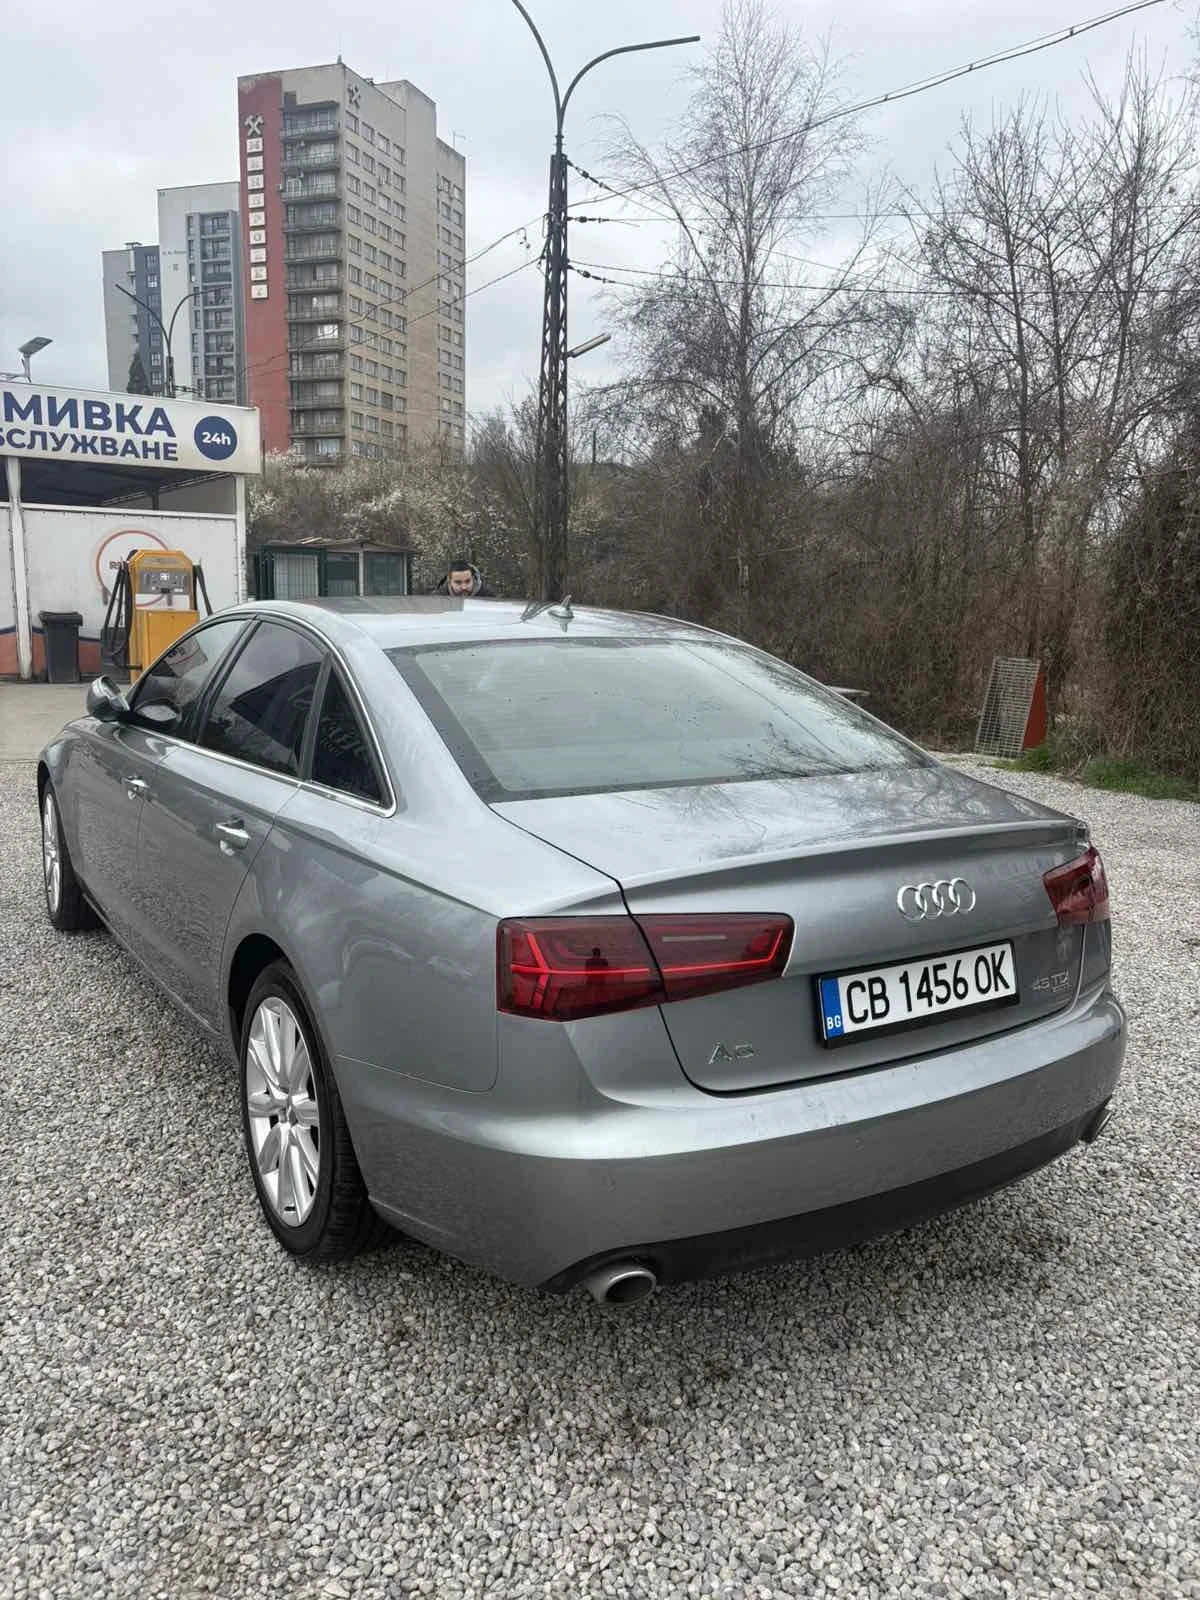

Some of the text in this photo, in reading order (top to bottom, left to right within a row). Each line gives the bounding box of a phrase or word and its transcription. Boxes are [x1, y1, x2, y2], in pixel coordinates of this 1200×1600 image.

[3, 391, 177, 438] МИВКА
[0, 427, 178, 461] СЛУЖВАНЕ
[201, 431, 232, 446] 24h
[846, 950, 1010, 1024] CB 1456 OK
[827, 1015, 842, 1030] BG
